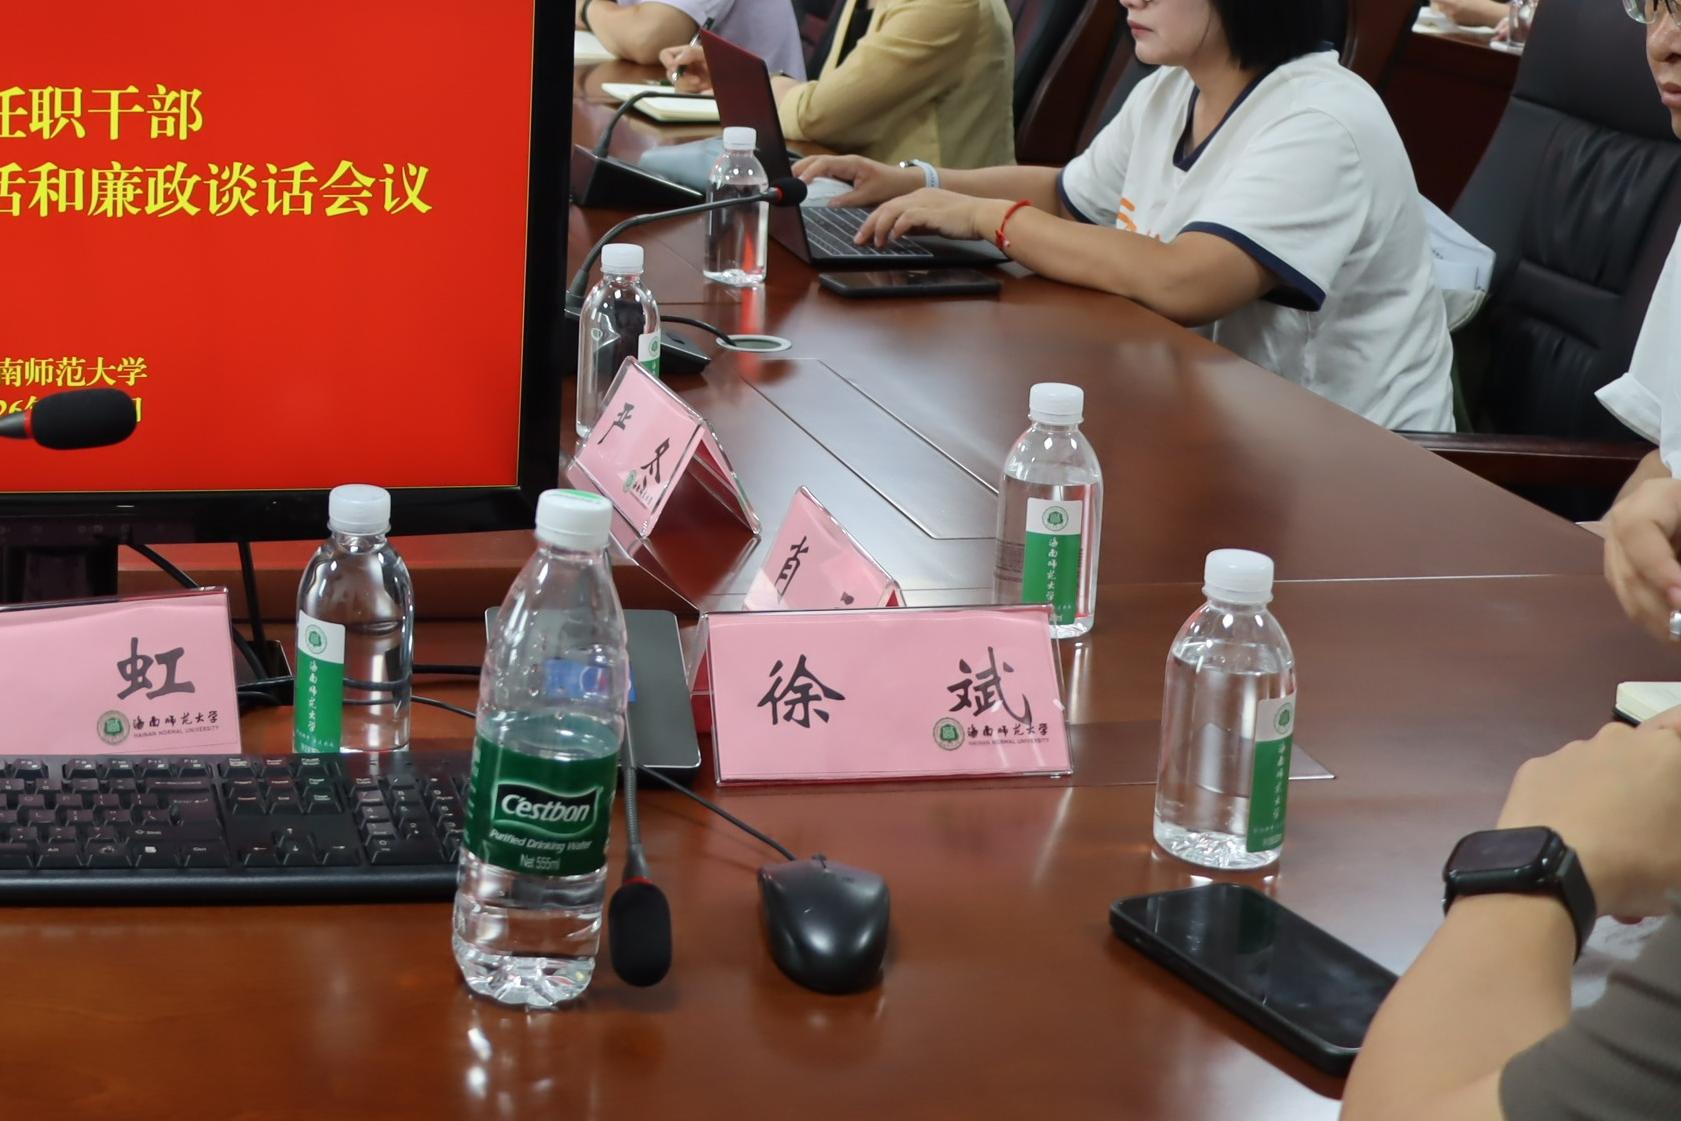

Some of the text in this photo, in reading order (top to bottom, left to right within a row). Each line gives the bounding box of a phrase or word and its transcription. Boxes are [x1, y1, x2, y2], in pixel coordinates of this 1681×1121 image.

[117, 637, 195, 700] 虹
[757, 646, 1033, 729] 徐 斌
[488, 830, 527, 847] Purified
[526, 838, 566, 854] Drinking
